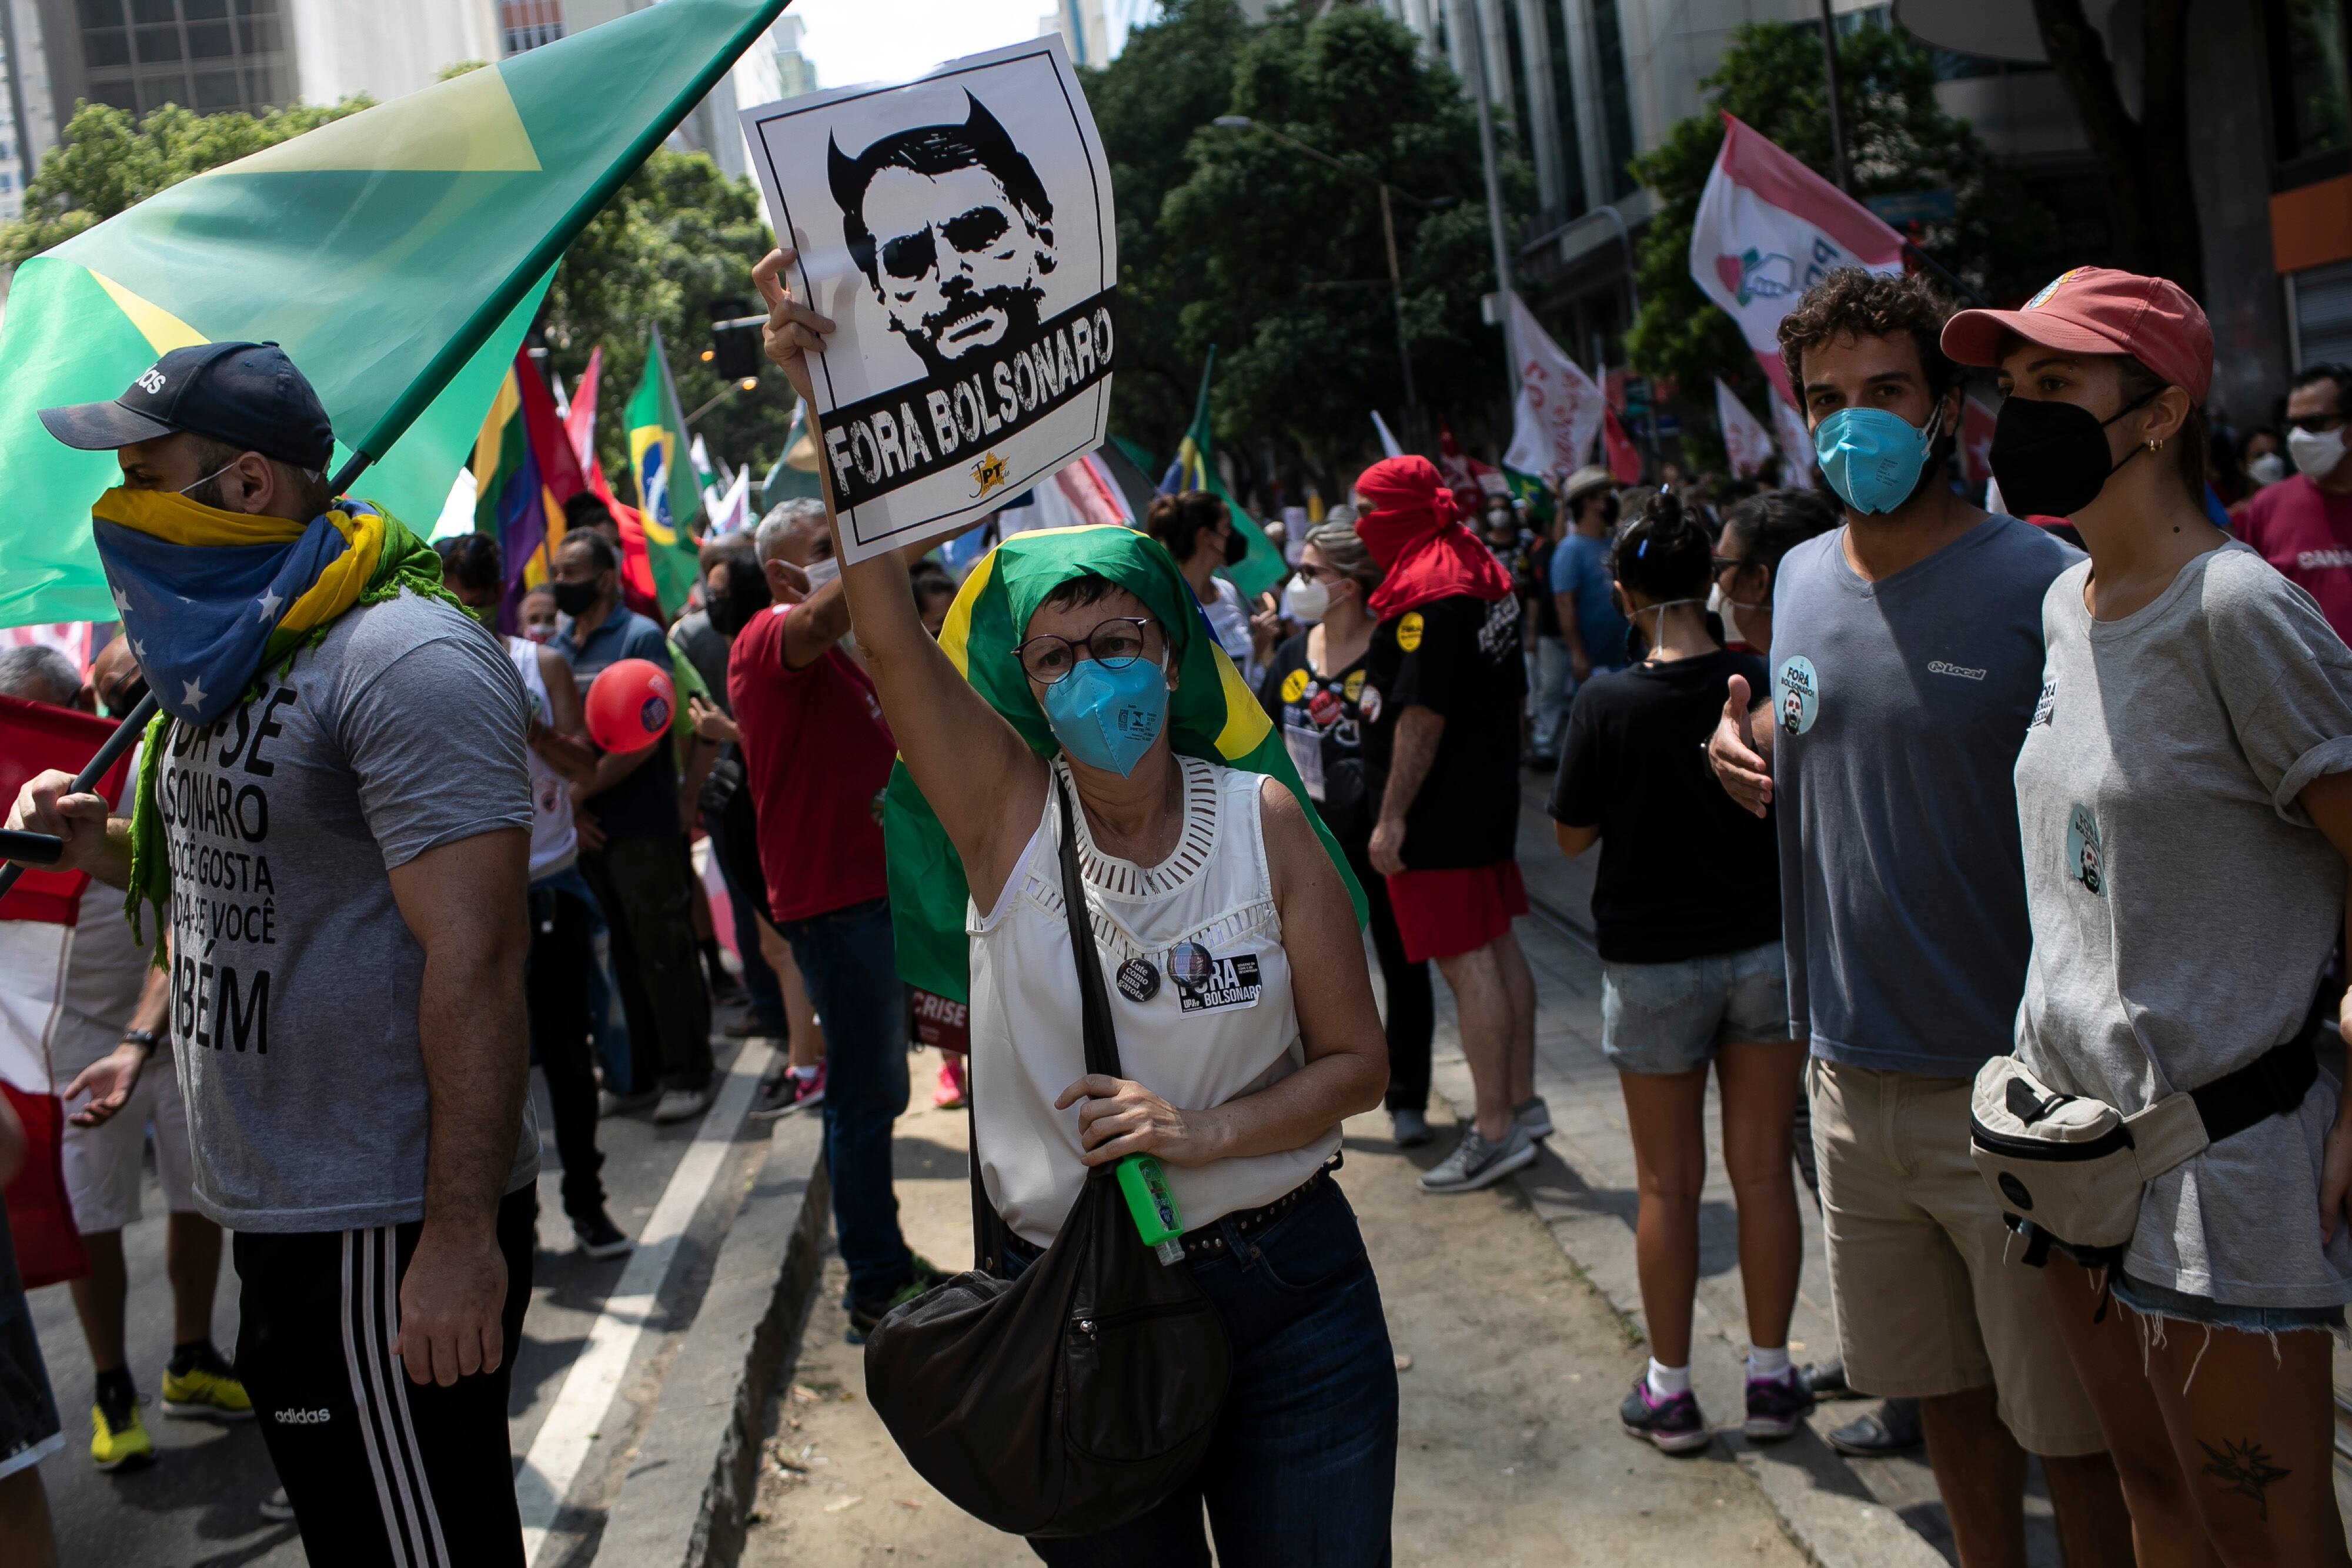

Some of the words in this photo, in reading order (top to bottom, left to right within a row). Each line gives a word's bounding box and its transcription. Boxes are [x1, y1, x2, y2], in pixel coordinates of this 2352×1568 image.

[824, 402, 933, 496] FORA
[926, 307, 1114, 455] BOLSONARO
[982, 462, 1003, 484] PT
[1787, 666, 1809, 687] FORA
[198, 845, 275, 895] GOSTA
[212, 897, 276, 944] VOCÊ
[1126, 967, 1148, 985] como
[1130, 959, 1148, 976] Lute
[1180, 956, 1240, 997] RA
[1117, 979, 1144, 1001] garota.
[1122, 973, 1140, 989] uma
[275, 1407, 330, 1423] adidas
